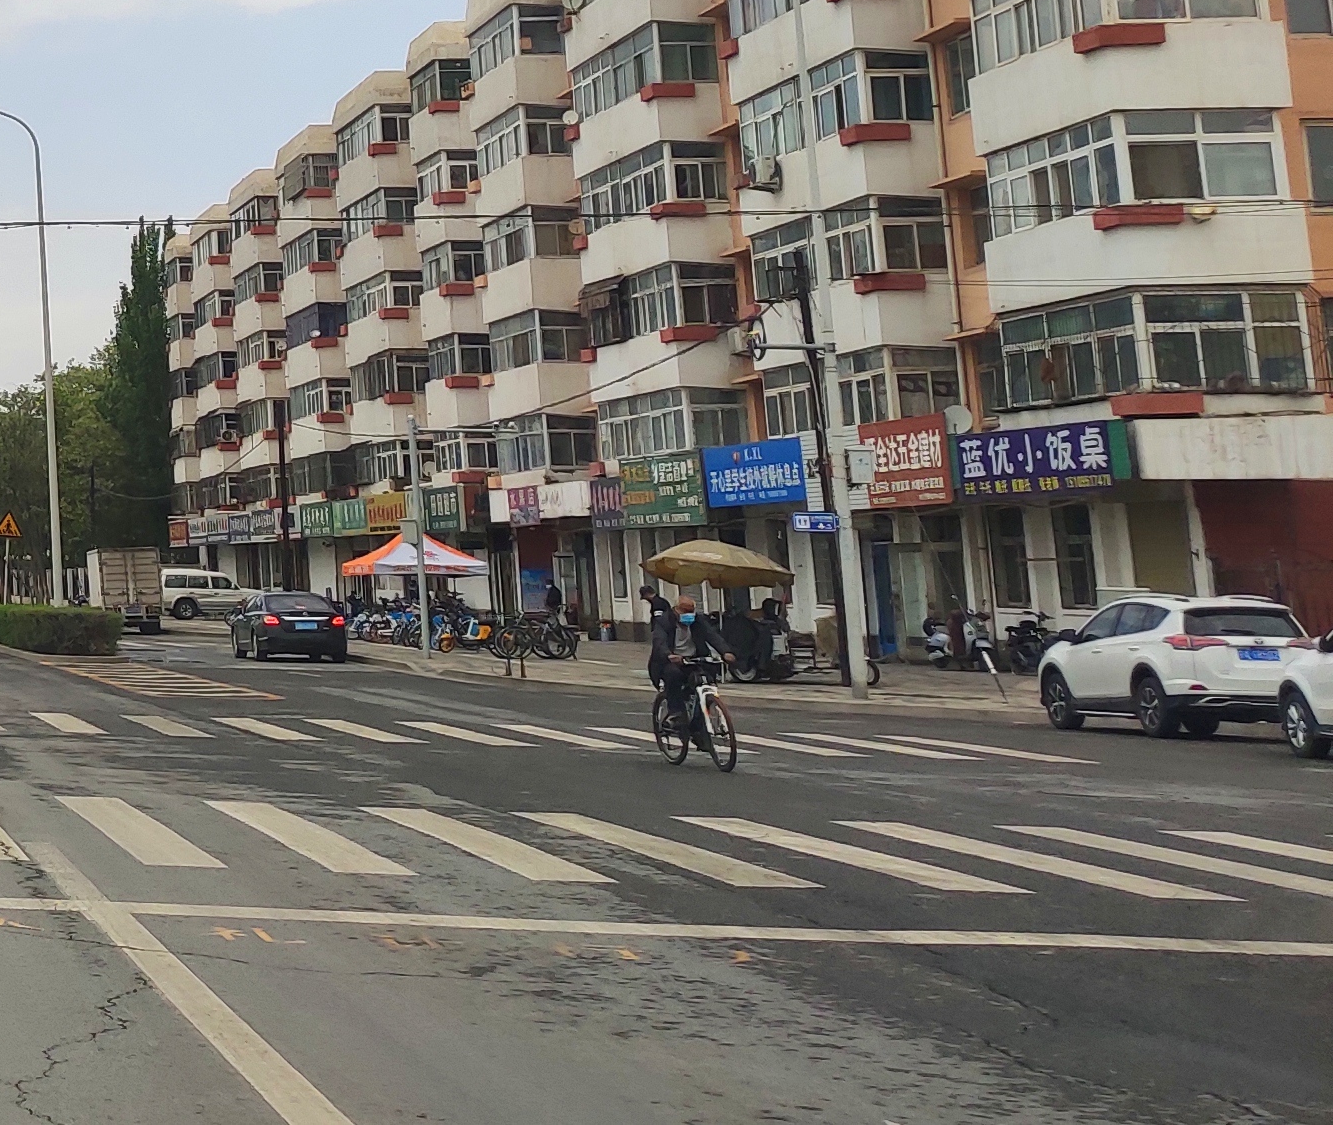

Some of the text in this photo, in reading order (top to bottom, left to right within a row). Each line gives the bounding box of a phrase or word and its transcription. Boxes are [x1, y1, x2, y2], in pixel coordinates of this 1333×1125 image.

[959, 425, 1109, 478] 蓝优小饭桌
